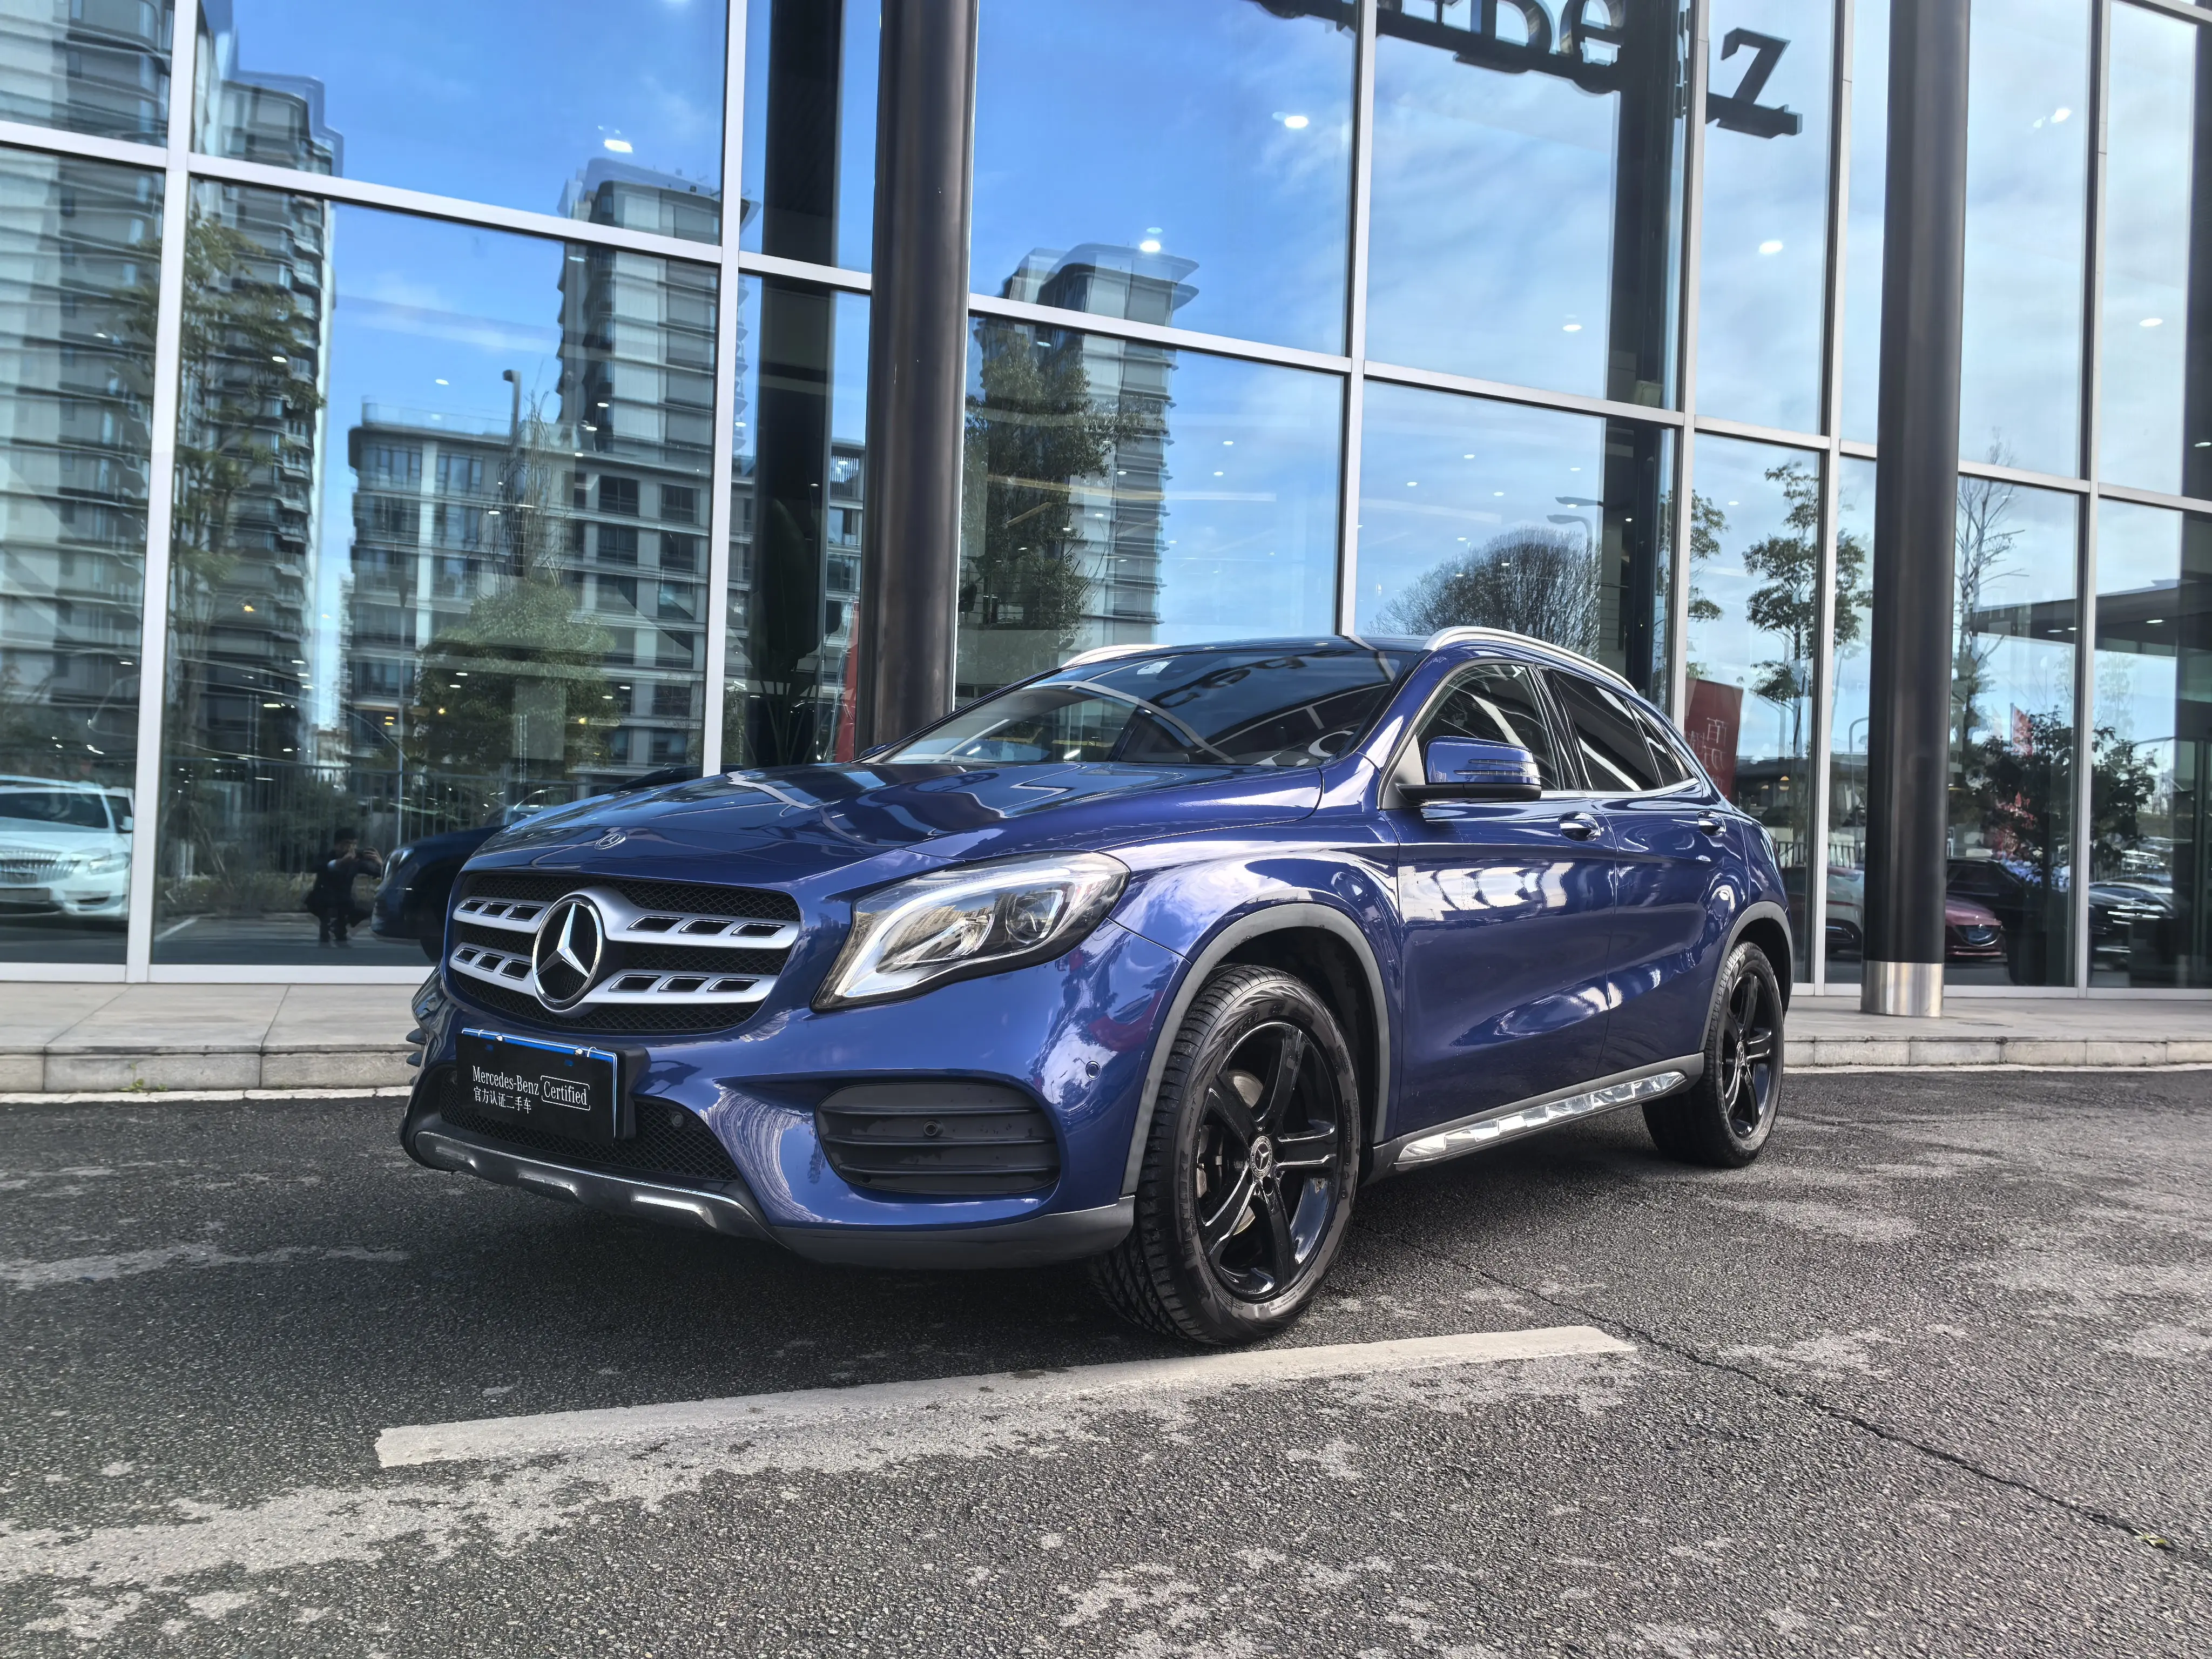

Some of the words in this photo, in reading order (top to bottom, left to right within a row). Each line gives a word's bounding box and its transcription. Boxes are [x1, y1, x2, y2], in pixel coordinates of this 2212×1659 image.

[473, 1065, 539, 1095] Mercedes-Benz
[543, 1081, 588, 1105] Certified
[473, 1086, 531, 1114] 官方认证二手车
